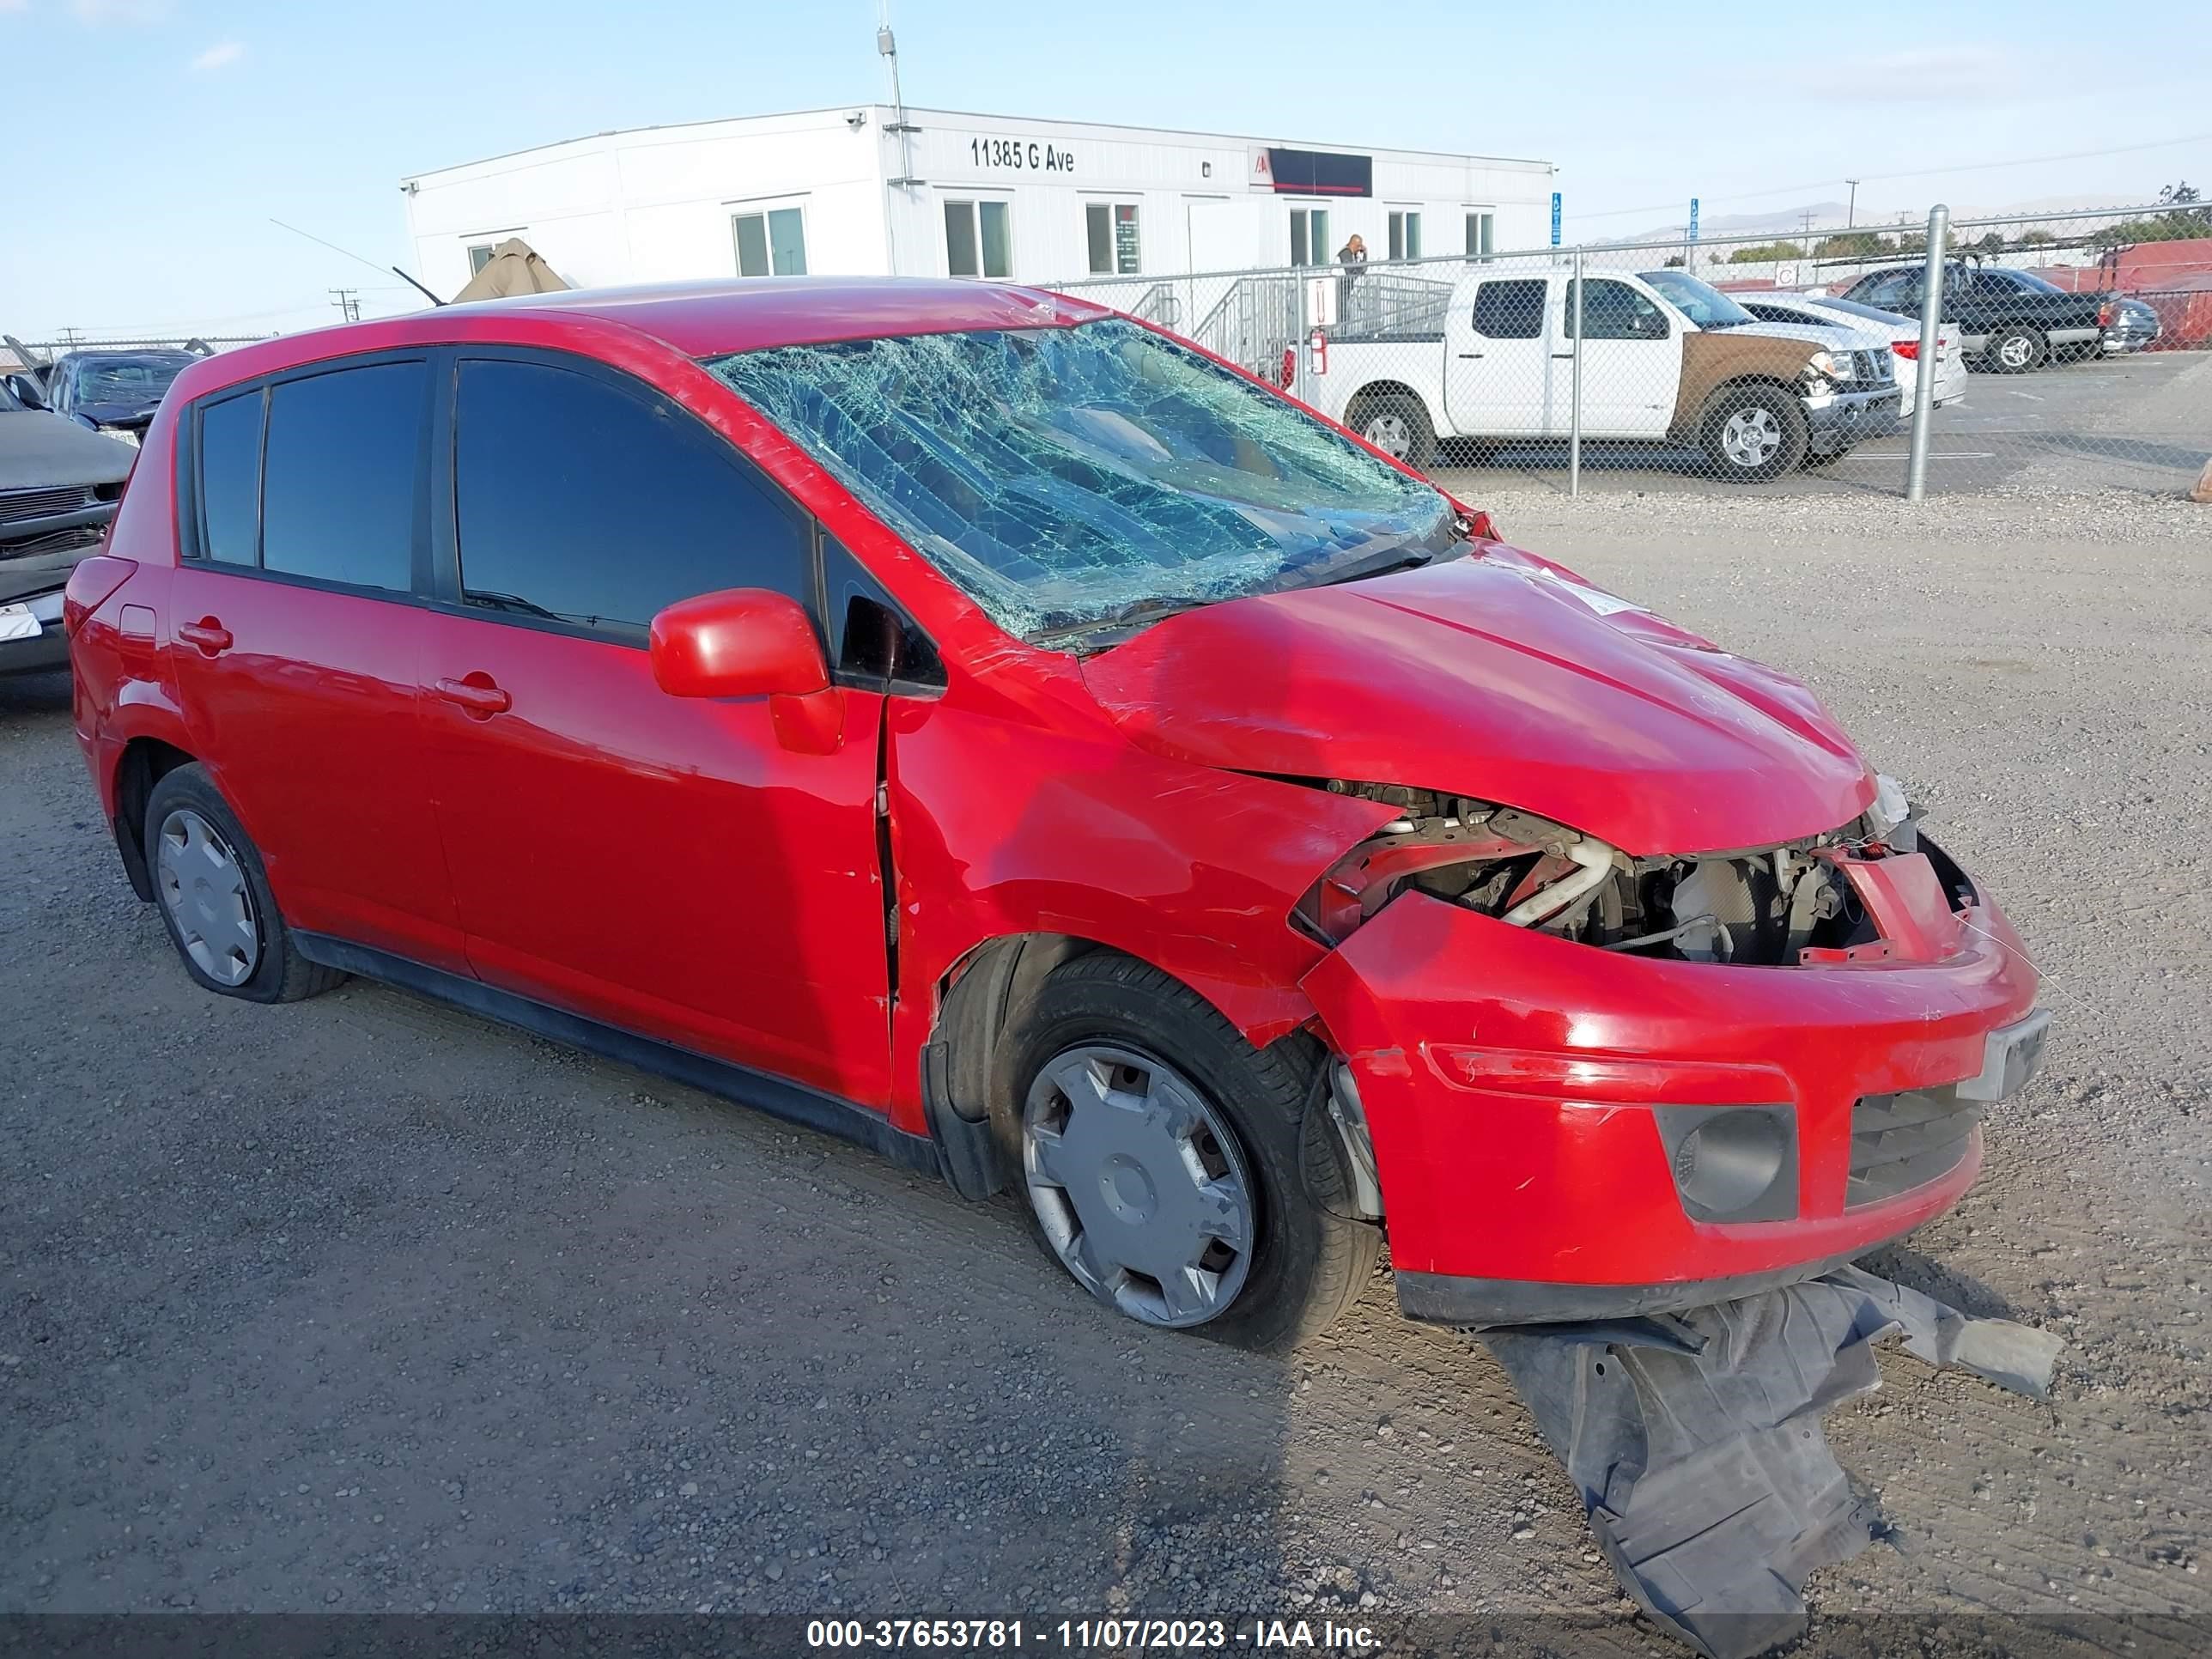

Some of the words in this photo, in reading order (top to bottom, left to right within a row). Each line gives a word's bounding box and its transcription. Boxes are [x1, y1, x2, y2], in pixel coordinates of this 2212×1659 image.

[971, 137, 1022, 169] 11385
[1028, 143, 1040, 169] G
[1046, 143, 1074, 172] Ave
